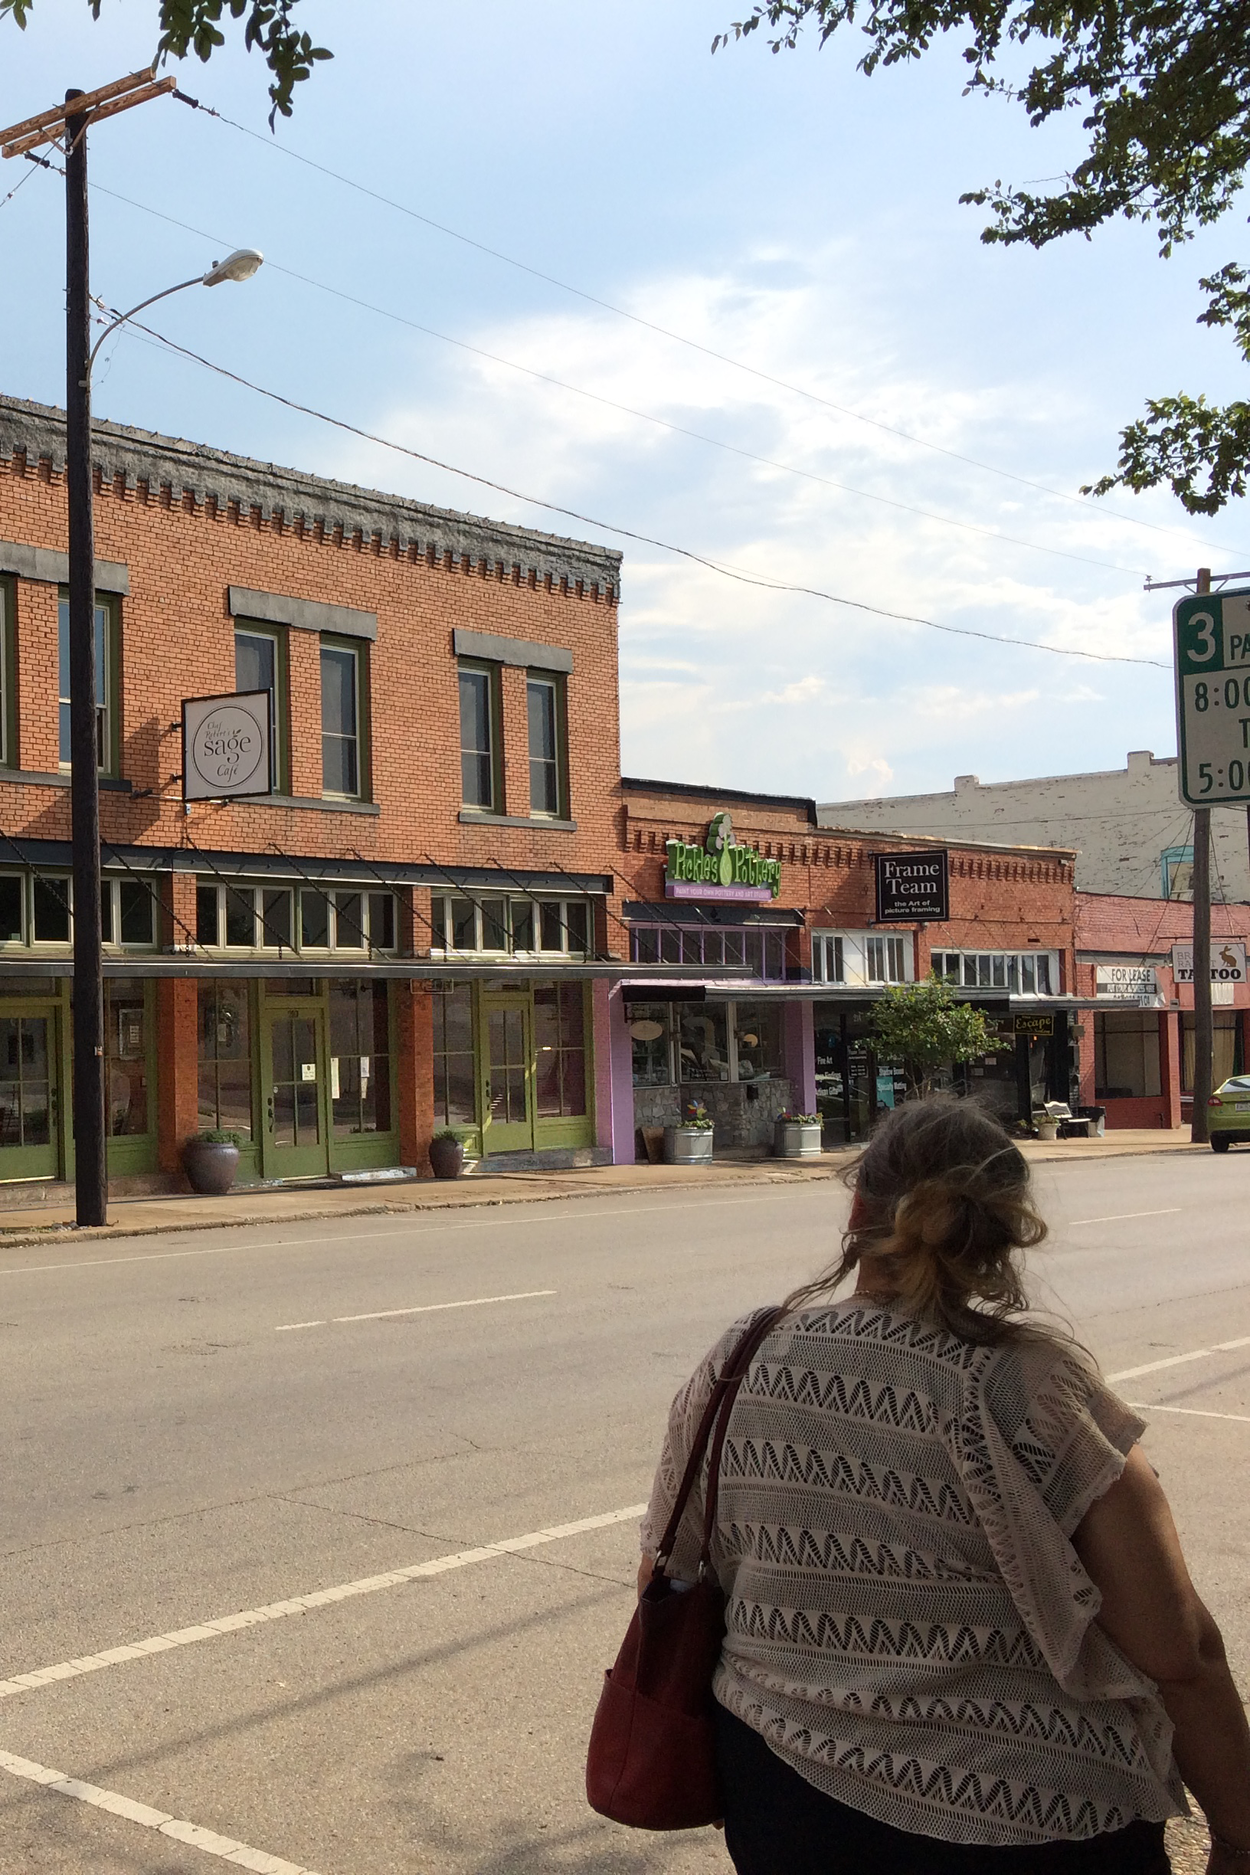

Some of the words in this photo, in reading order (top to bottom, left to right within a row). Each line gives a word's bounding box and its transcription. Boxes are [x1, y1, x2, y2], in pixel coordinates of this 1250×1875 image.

[1186, 611, 1216, 662] 3
[1199, 760, 1250, 793] 5:0
[674, 842, 718, 883] Pickles
[734, 847, 781, 899] Pottery
[884, 861, 940, 878] Frame
[885, 878, 938, 895] Team
[884, 907, 910, 915] picture
[1178, 960, 1216, 968] RAT
[1111, 968, 1127, 981] FOR
[1129, 969, 1151, 982] LEASE
[1178, 968, 1241, 980] TATOO
[1016, 1017, 1052, 1030] Escape
